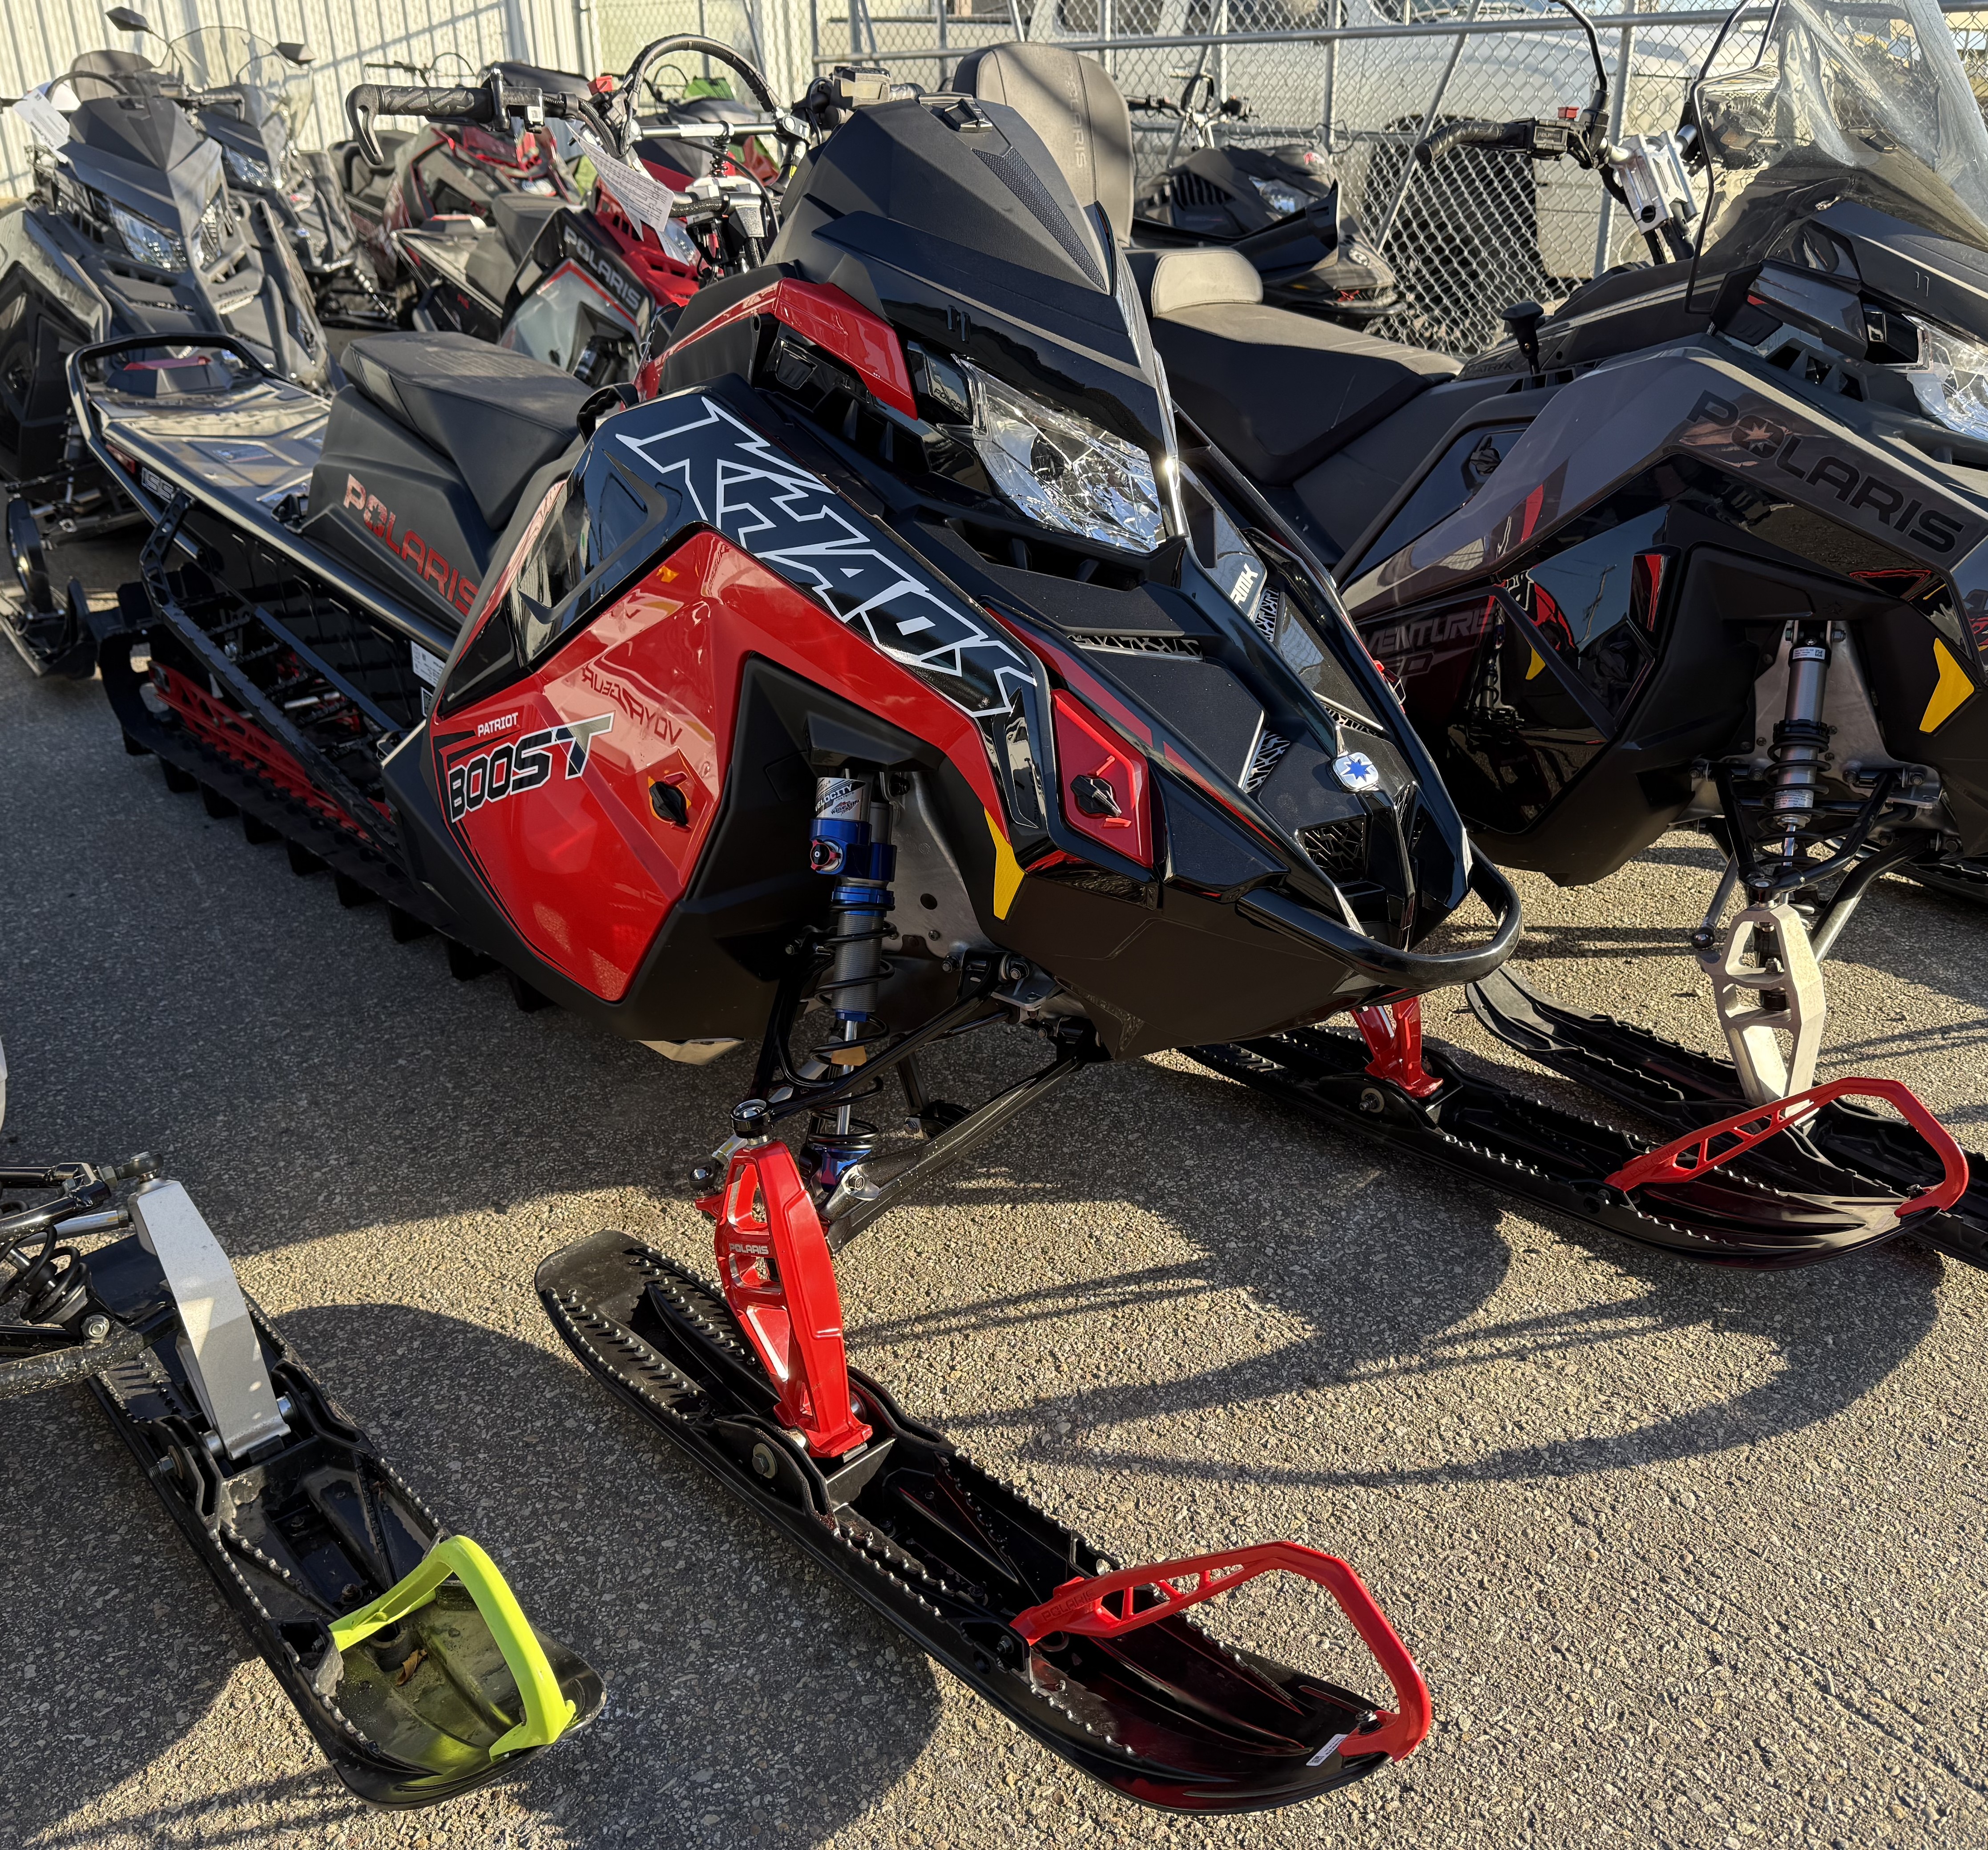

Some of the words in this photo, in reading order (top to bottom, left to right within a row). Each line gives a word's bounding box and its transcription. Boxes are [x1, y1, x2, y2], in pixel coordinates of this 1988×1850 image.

[1064, 63, 1087, 168] POLARIS
[563, 225, 641, 310] POLARIS
[1685, 389, 1965, 554] POLARIS
[343, 473, 479, 617] POLARIS
[616, 396, 1037, 717] KHAOS
[448, 710, 616, 823] BOOST
[477, 712, 519, 737] PATRIOT
[729, 1243, 769, 1255] POLARIS
[1041, 1588, 1095, 1622] POLARIS
